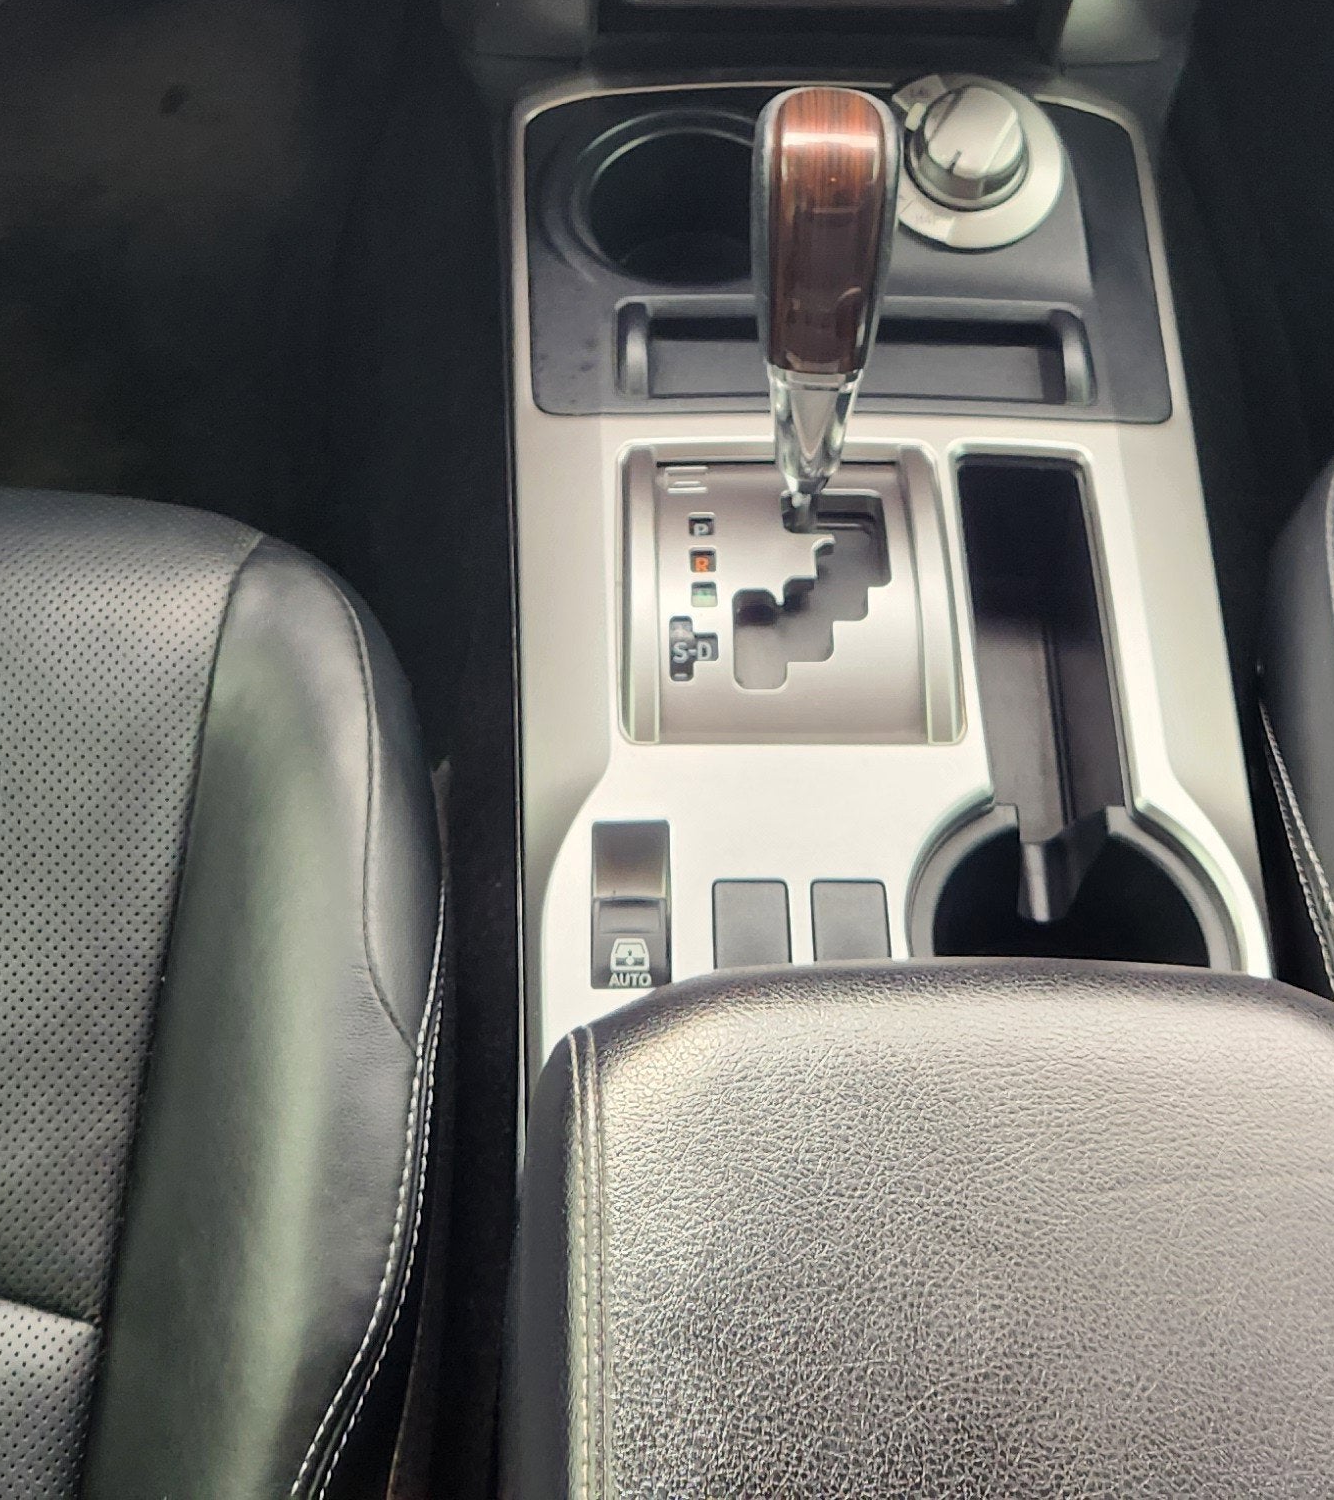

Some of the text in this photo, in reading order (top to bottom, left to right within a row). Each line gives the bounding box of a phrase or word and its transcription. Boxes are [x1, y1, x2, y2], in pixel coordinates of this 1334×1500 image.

[693, 523, 709, 536] P
[695, 556, 709, 572] R
[609, 972, 652, 988] AUTO
